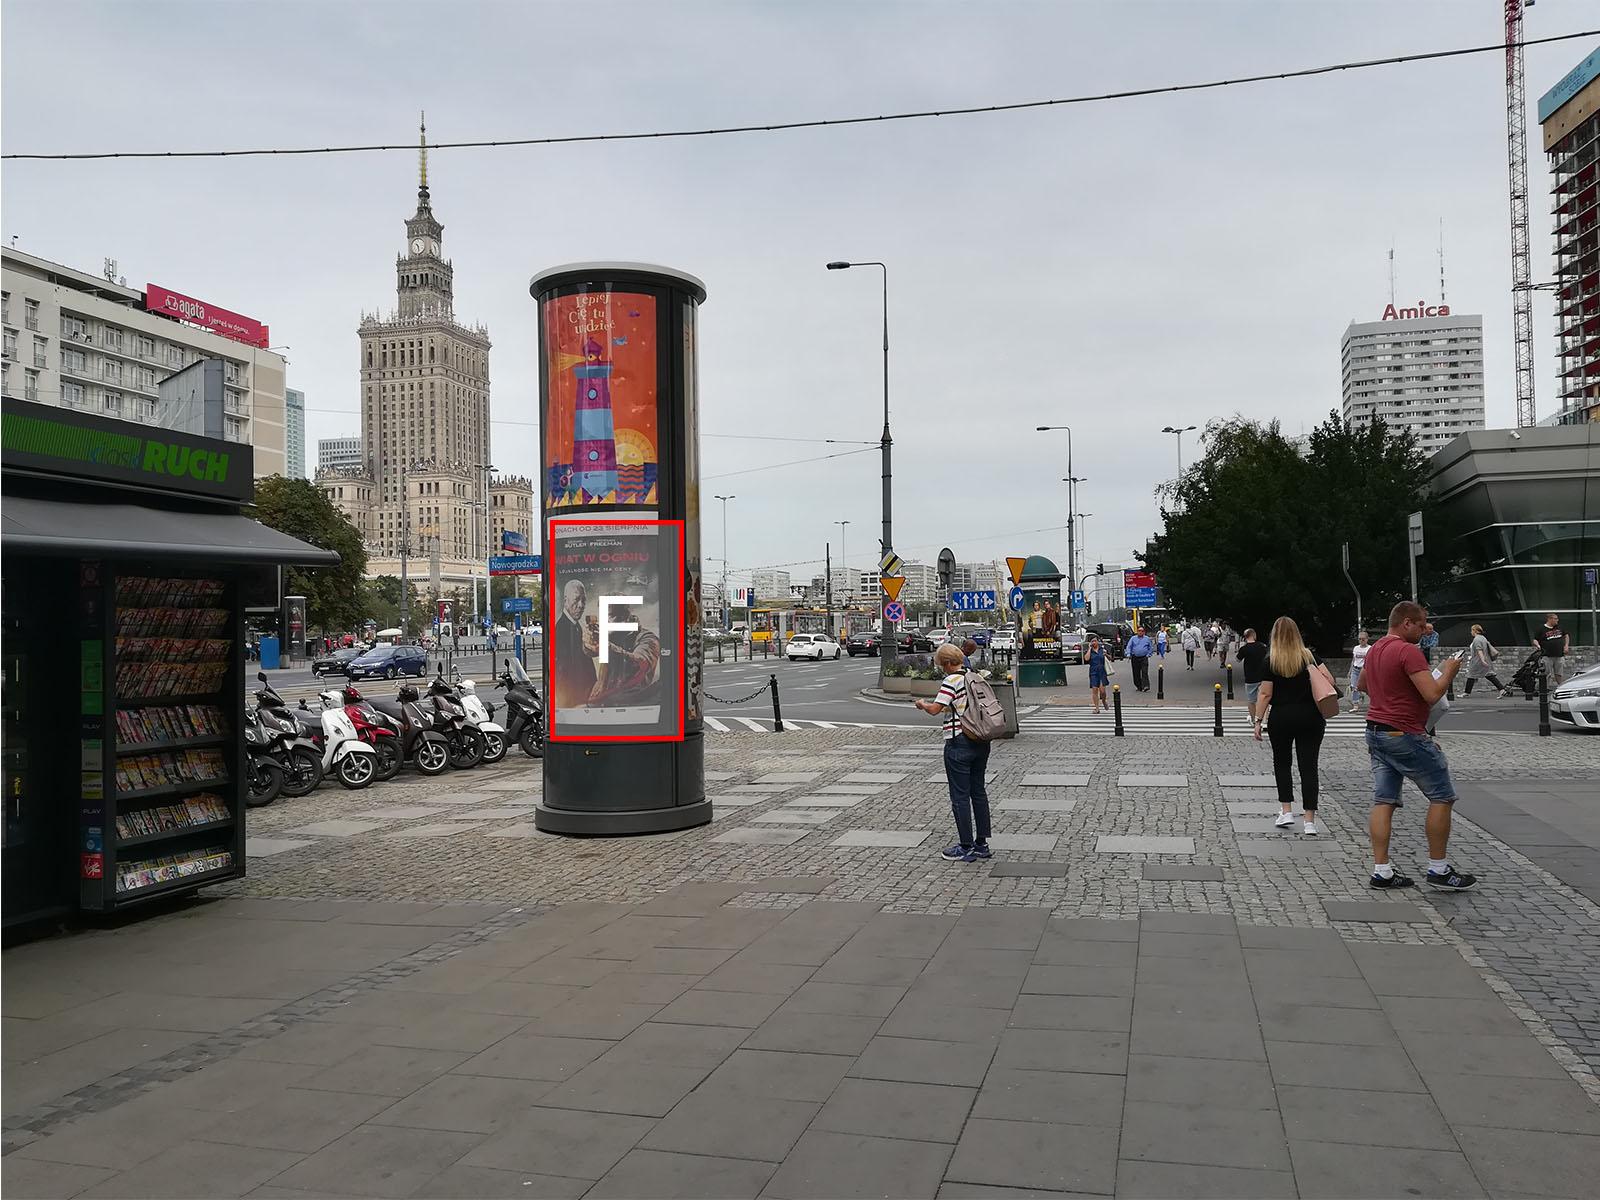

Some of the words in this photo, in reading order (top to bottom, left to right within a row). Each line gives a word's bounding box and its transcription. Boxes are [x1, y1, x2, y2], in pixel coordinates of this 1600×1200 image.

[575, 293, 610, 308] Lepiej
[179, 299, 205, 320] agata
[593, 308, 605, 319] tu
[1382, 300, 1450, 321] Amica
[144, 441, 229, 482] RUCH
[583, 553, 595, 563] W
[599, 551, 648, 562] OGNIU
[491, 559, 539, 570] Nowogrodzka
[1074, 592, 1082, 603] P
